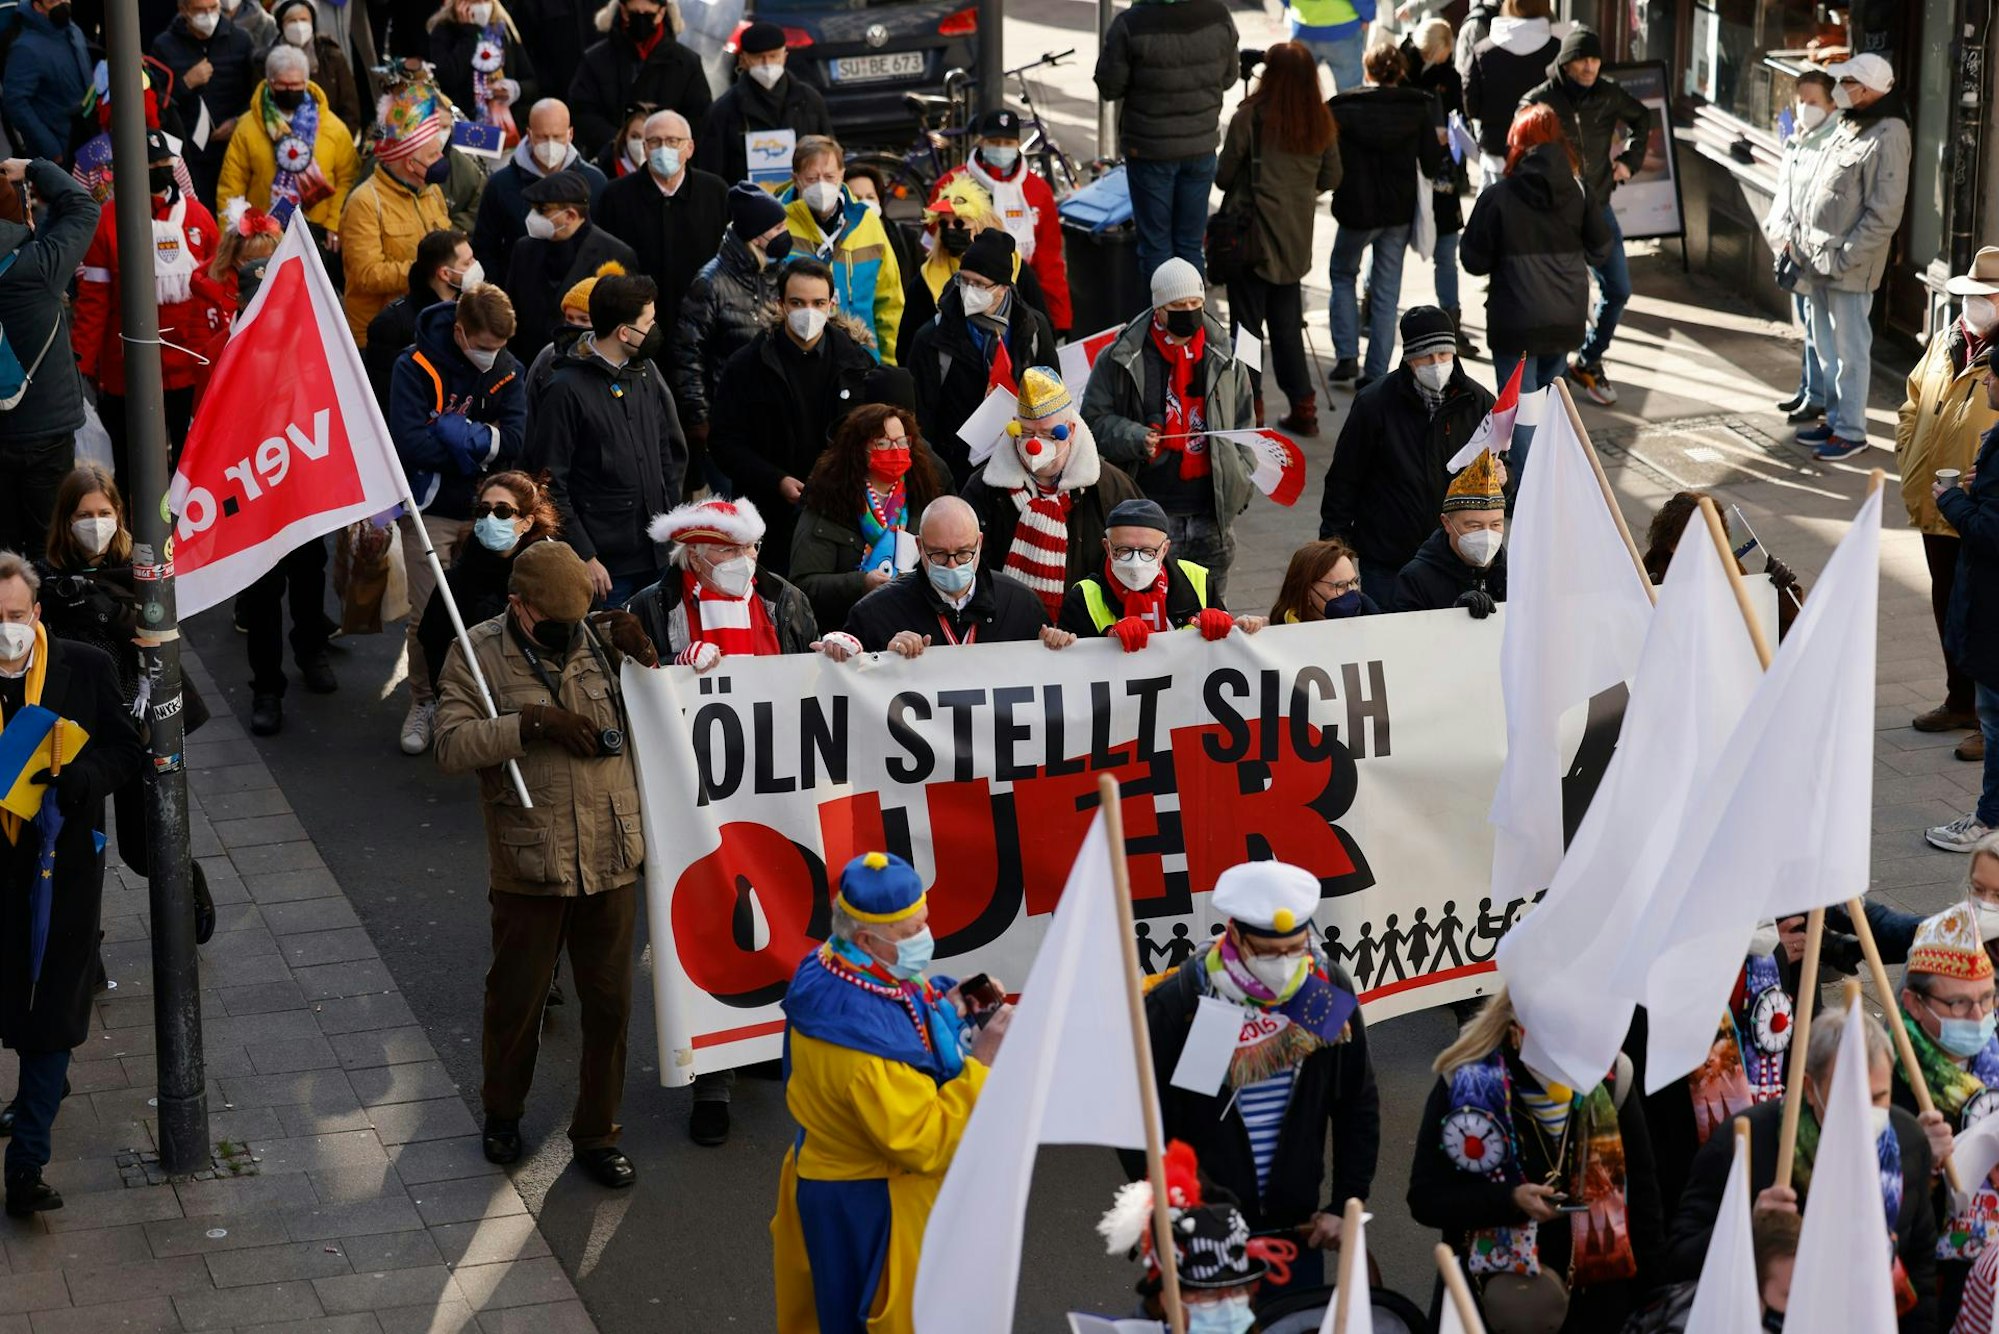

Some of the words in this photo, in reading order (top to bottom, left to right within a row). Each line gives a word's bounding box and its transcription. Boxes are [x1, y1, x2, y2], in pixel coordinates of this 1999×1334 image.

[840, 61, 859, 76] SU
[870, 58, 890, 74] BE
[892, 55, 920, 72] 673
[682, 676, 849, 807] ÖLN
[885, 675, 1172, 784] STELLT
[1202, 660, 1391, 764] SICH
[672, 717, 1376, 1008] QUER
[1239, 1018, 1278, 1042] 2015
